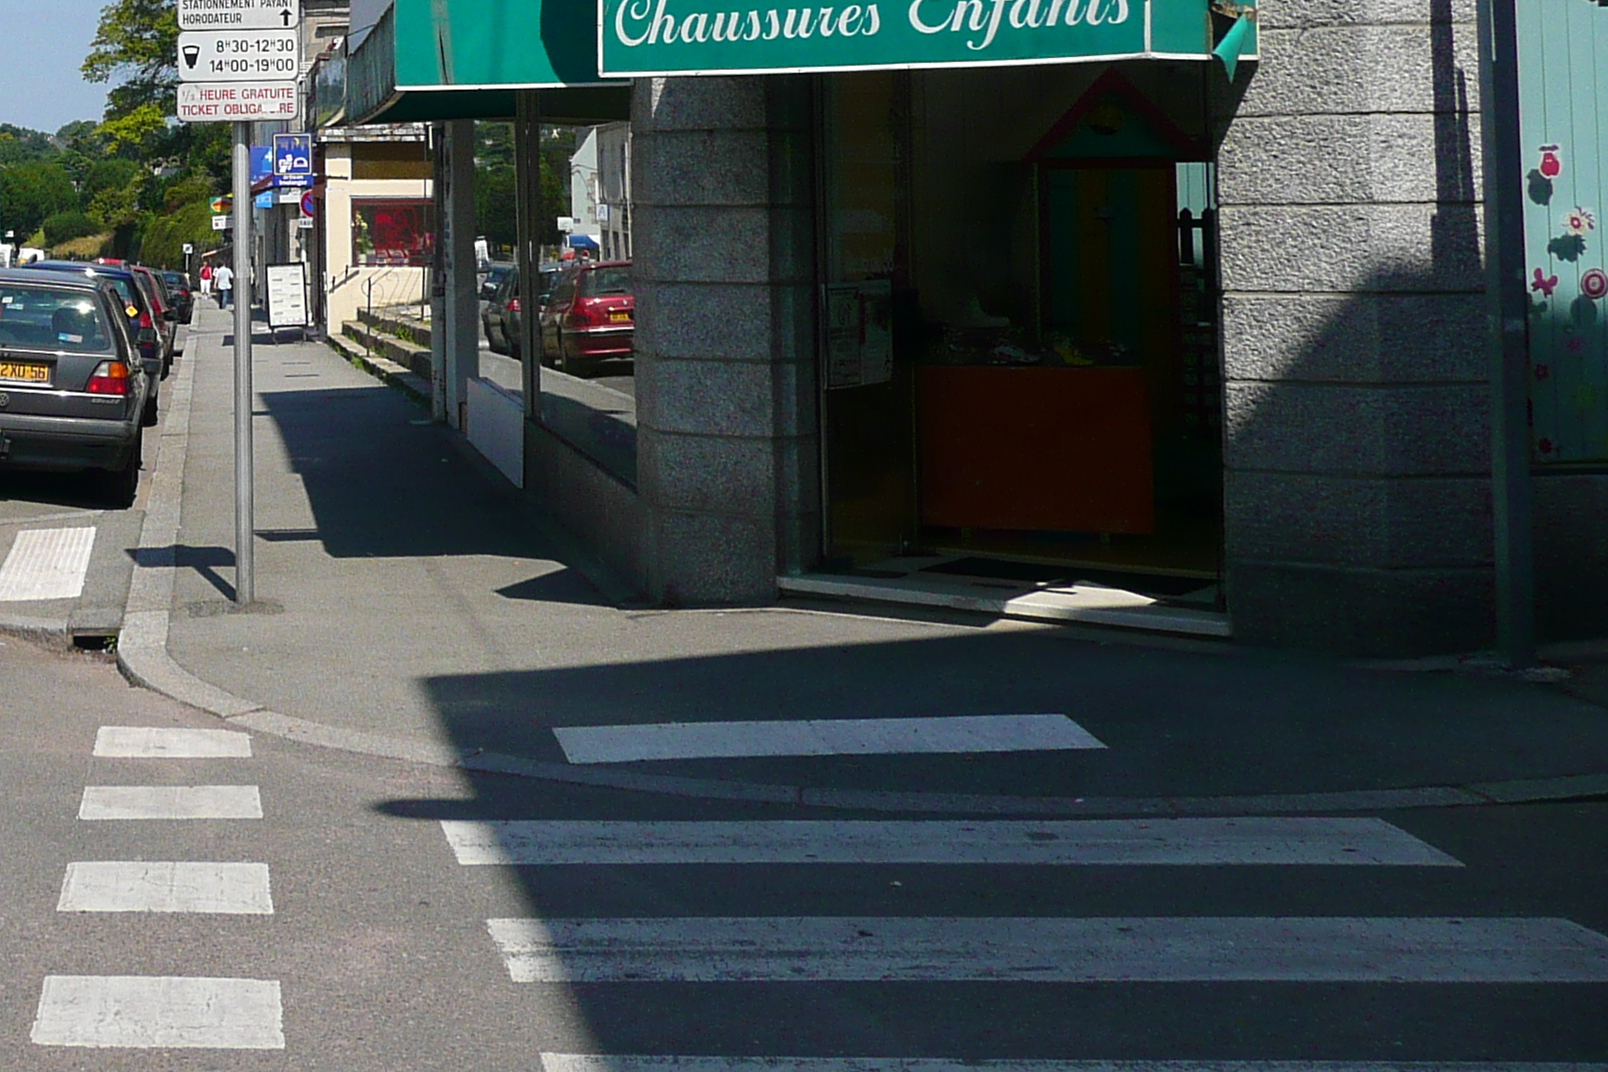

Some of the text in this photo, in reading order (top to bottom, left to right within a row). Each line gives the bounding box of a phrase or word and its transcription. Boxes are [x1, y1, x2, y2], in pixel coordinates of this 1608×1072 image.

[182, 13, 243, 24] HORODATEUR
[200, 89, 236, 100] HEURE
[241, 88, 294, 100] GRATUITE
[181, 103, 294, 115] TICKET OBLIGARE
